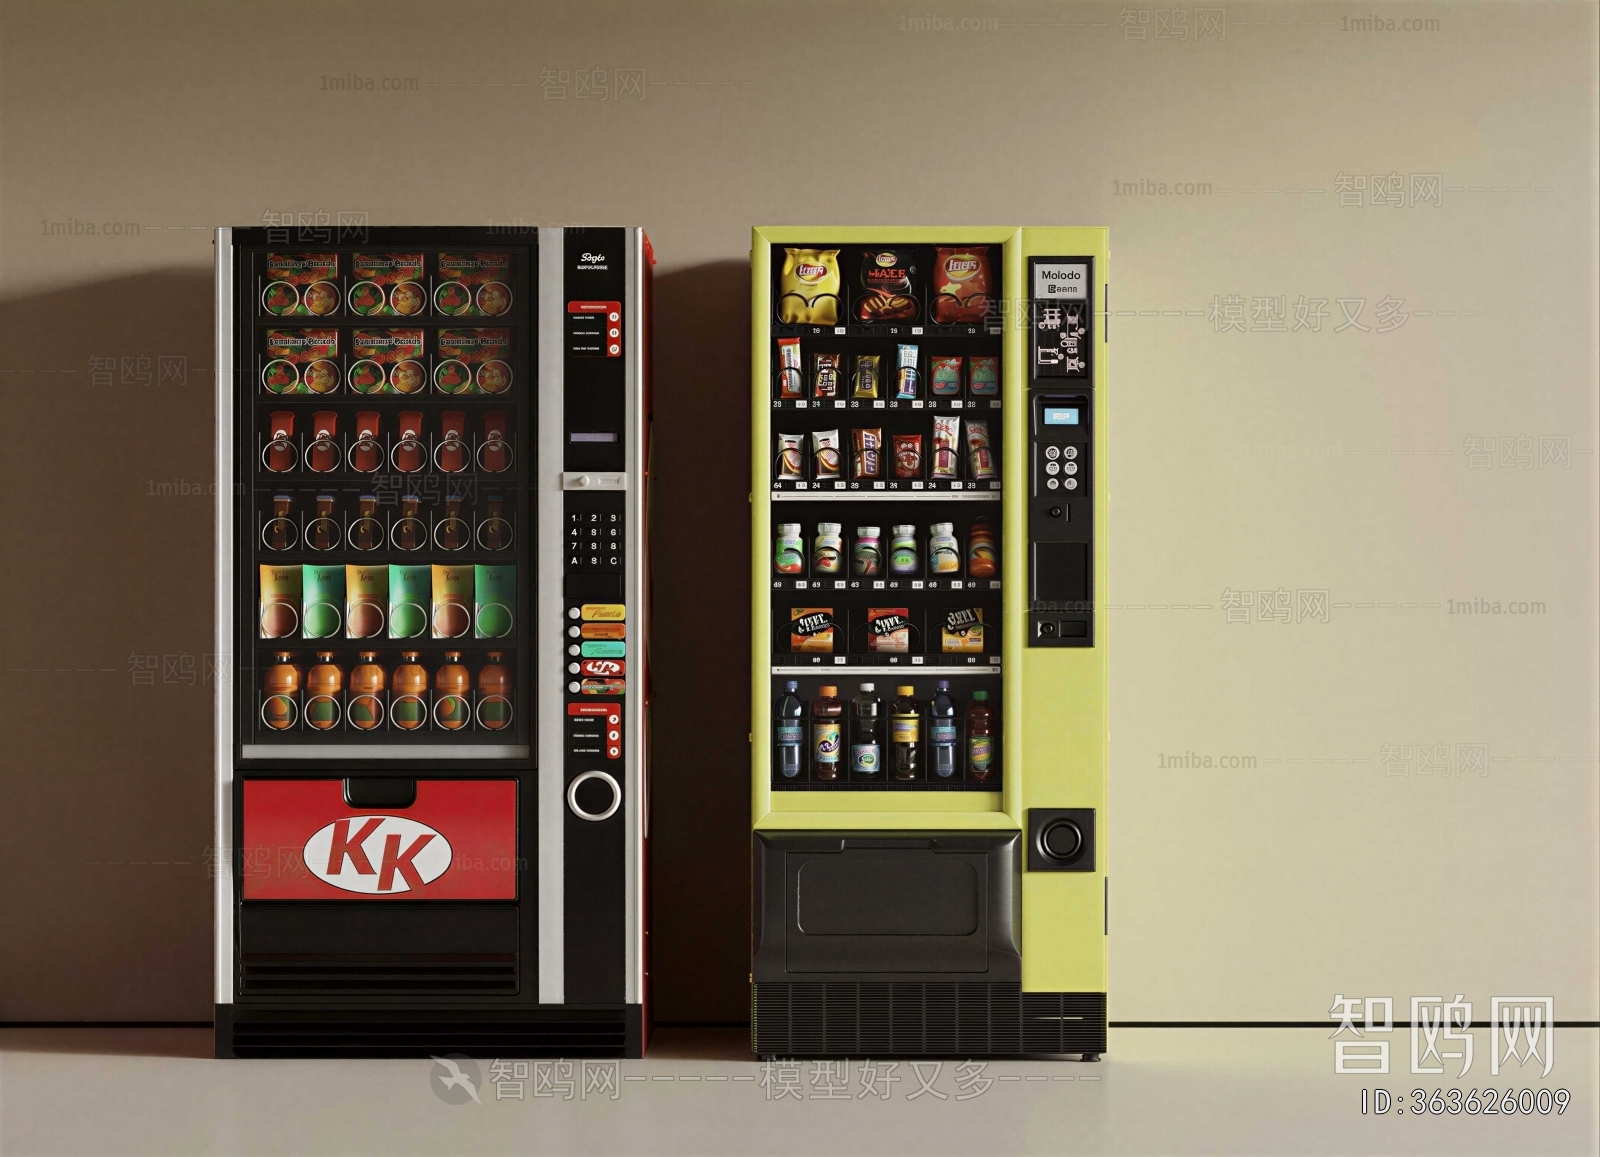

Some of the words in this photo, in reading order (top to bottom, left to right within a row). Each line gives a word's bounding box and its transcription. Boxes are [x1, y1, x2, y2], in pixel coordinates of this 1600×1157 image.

[1041, 270, 1081, 280] Molodo
[590, 514, 597, 522] 2
[571, 528, 578, 537] 4
[610, 528, 617, 536] 6
[571, 542, 577, 550] 7
[590, 542, 597, 550] 8
[571, 556, 578, 565] A
[610, 556, 618, 565] C
[326, 817, 437, 892] KK
